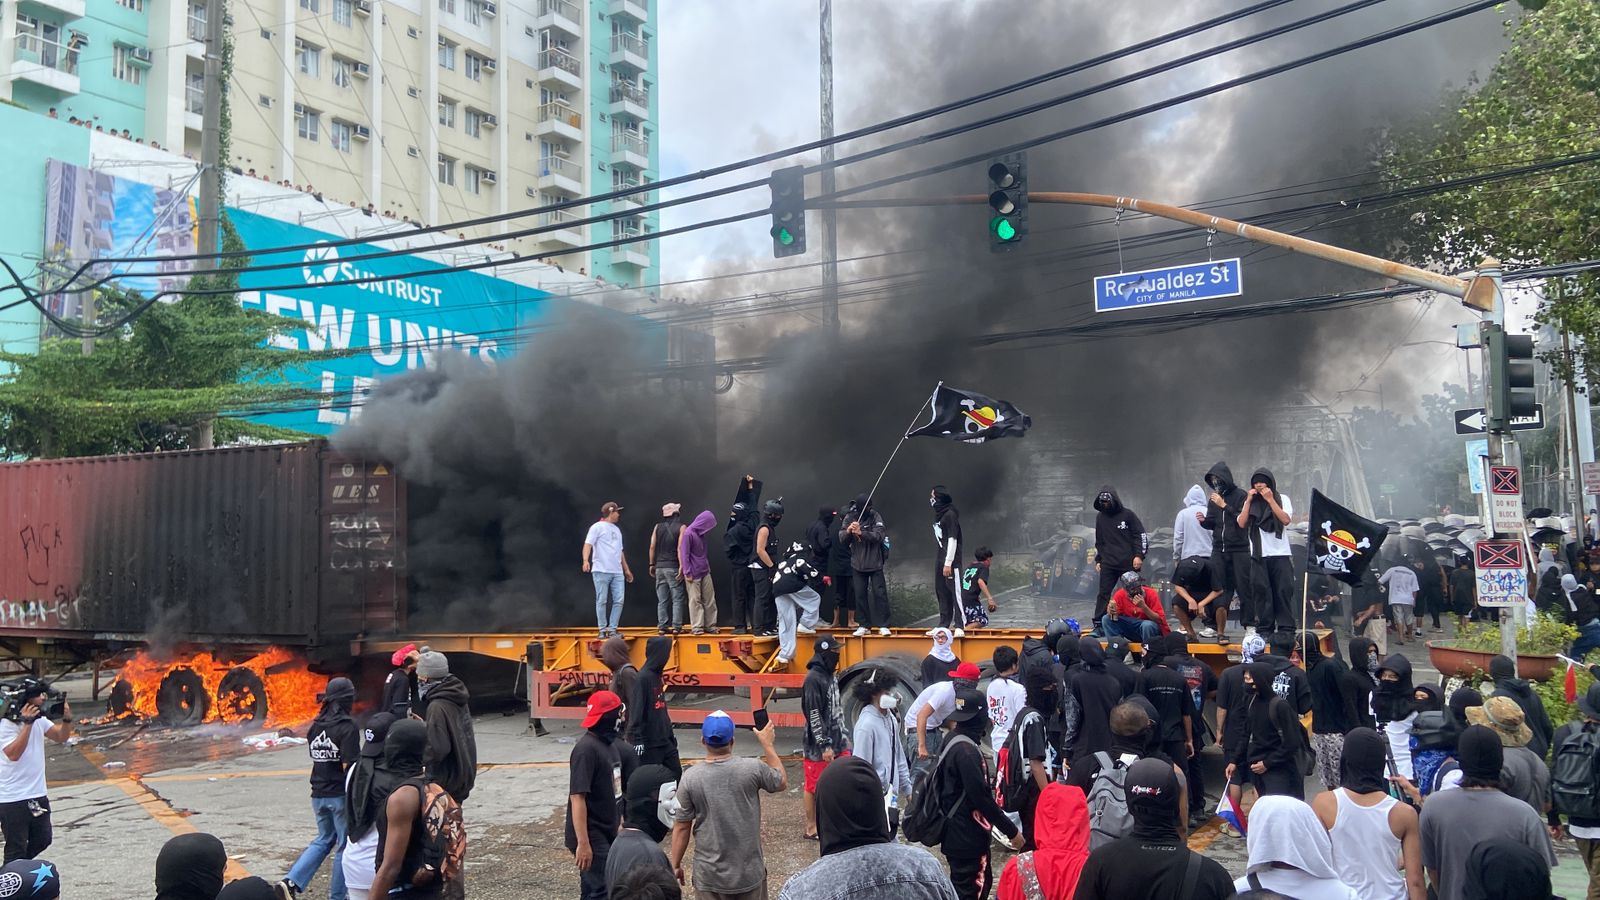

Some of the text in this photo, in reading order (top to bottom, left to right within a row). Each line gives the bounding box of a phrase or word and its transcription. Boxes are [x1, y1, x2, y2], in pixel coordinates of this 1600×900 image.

[1210, 266, 1230, 284] St
[340, 262, 442, 307] SUNTRUST
[1136, 289, 1197, 303] CITY OF MANILA
